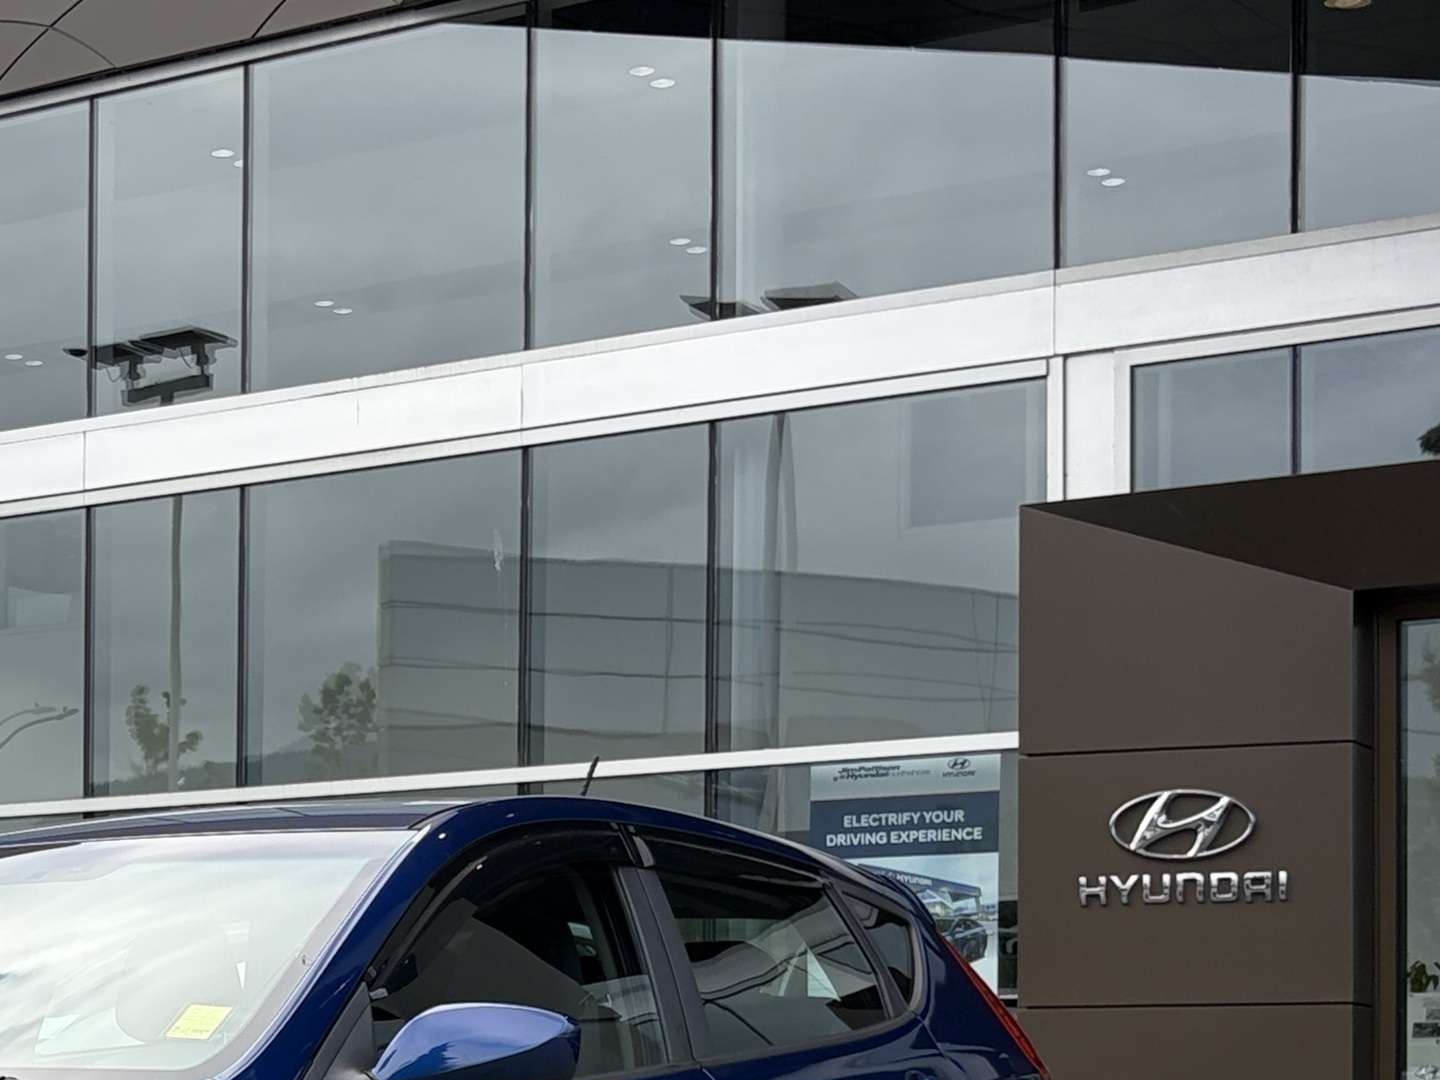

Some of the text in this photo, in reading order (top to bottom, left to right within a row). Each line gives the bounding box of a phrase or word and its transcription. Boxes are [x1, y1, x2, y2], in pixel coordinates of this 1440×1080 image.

[843, 810, 965, 828] ELECTRIFY YOUR
[826, 827, 983, 847] DRIVING EXPERIENCE
[1078, 870, 1288, 907] HYUNDAI
